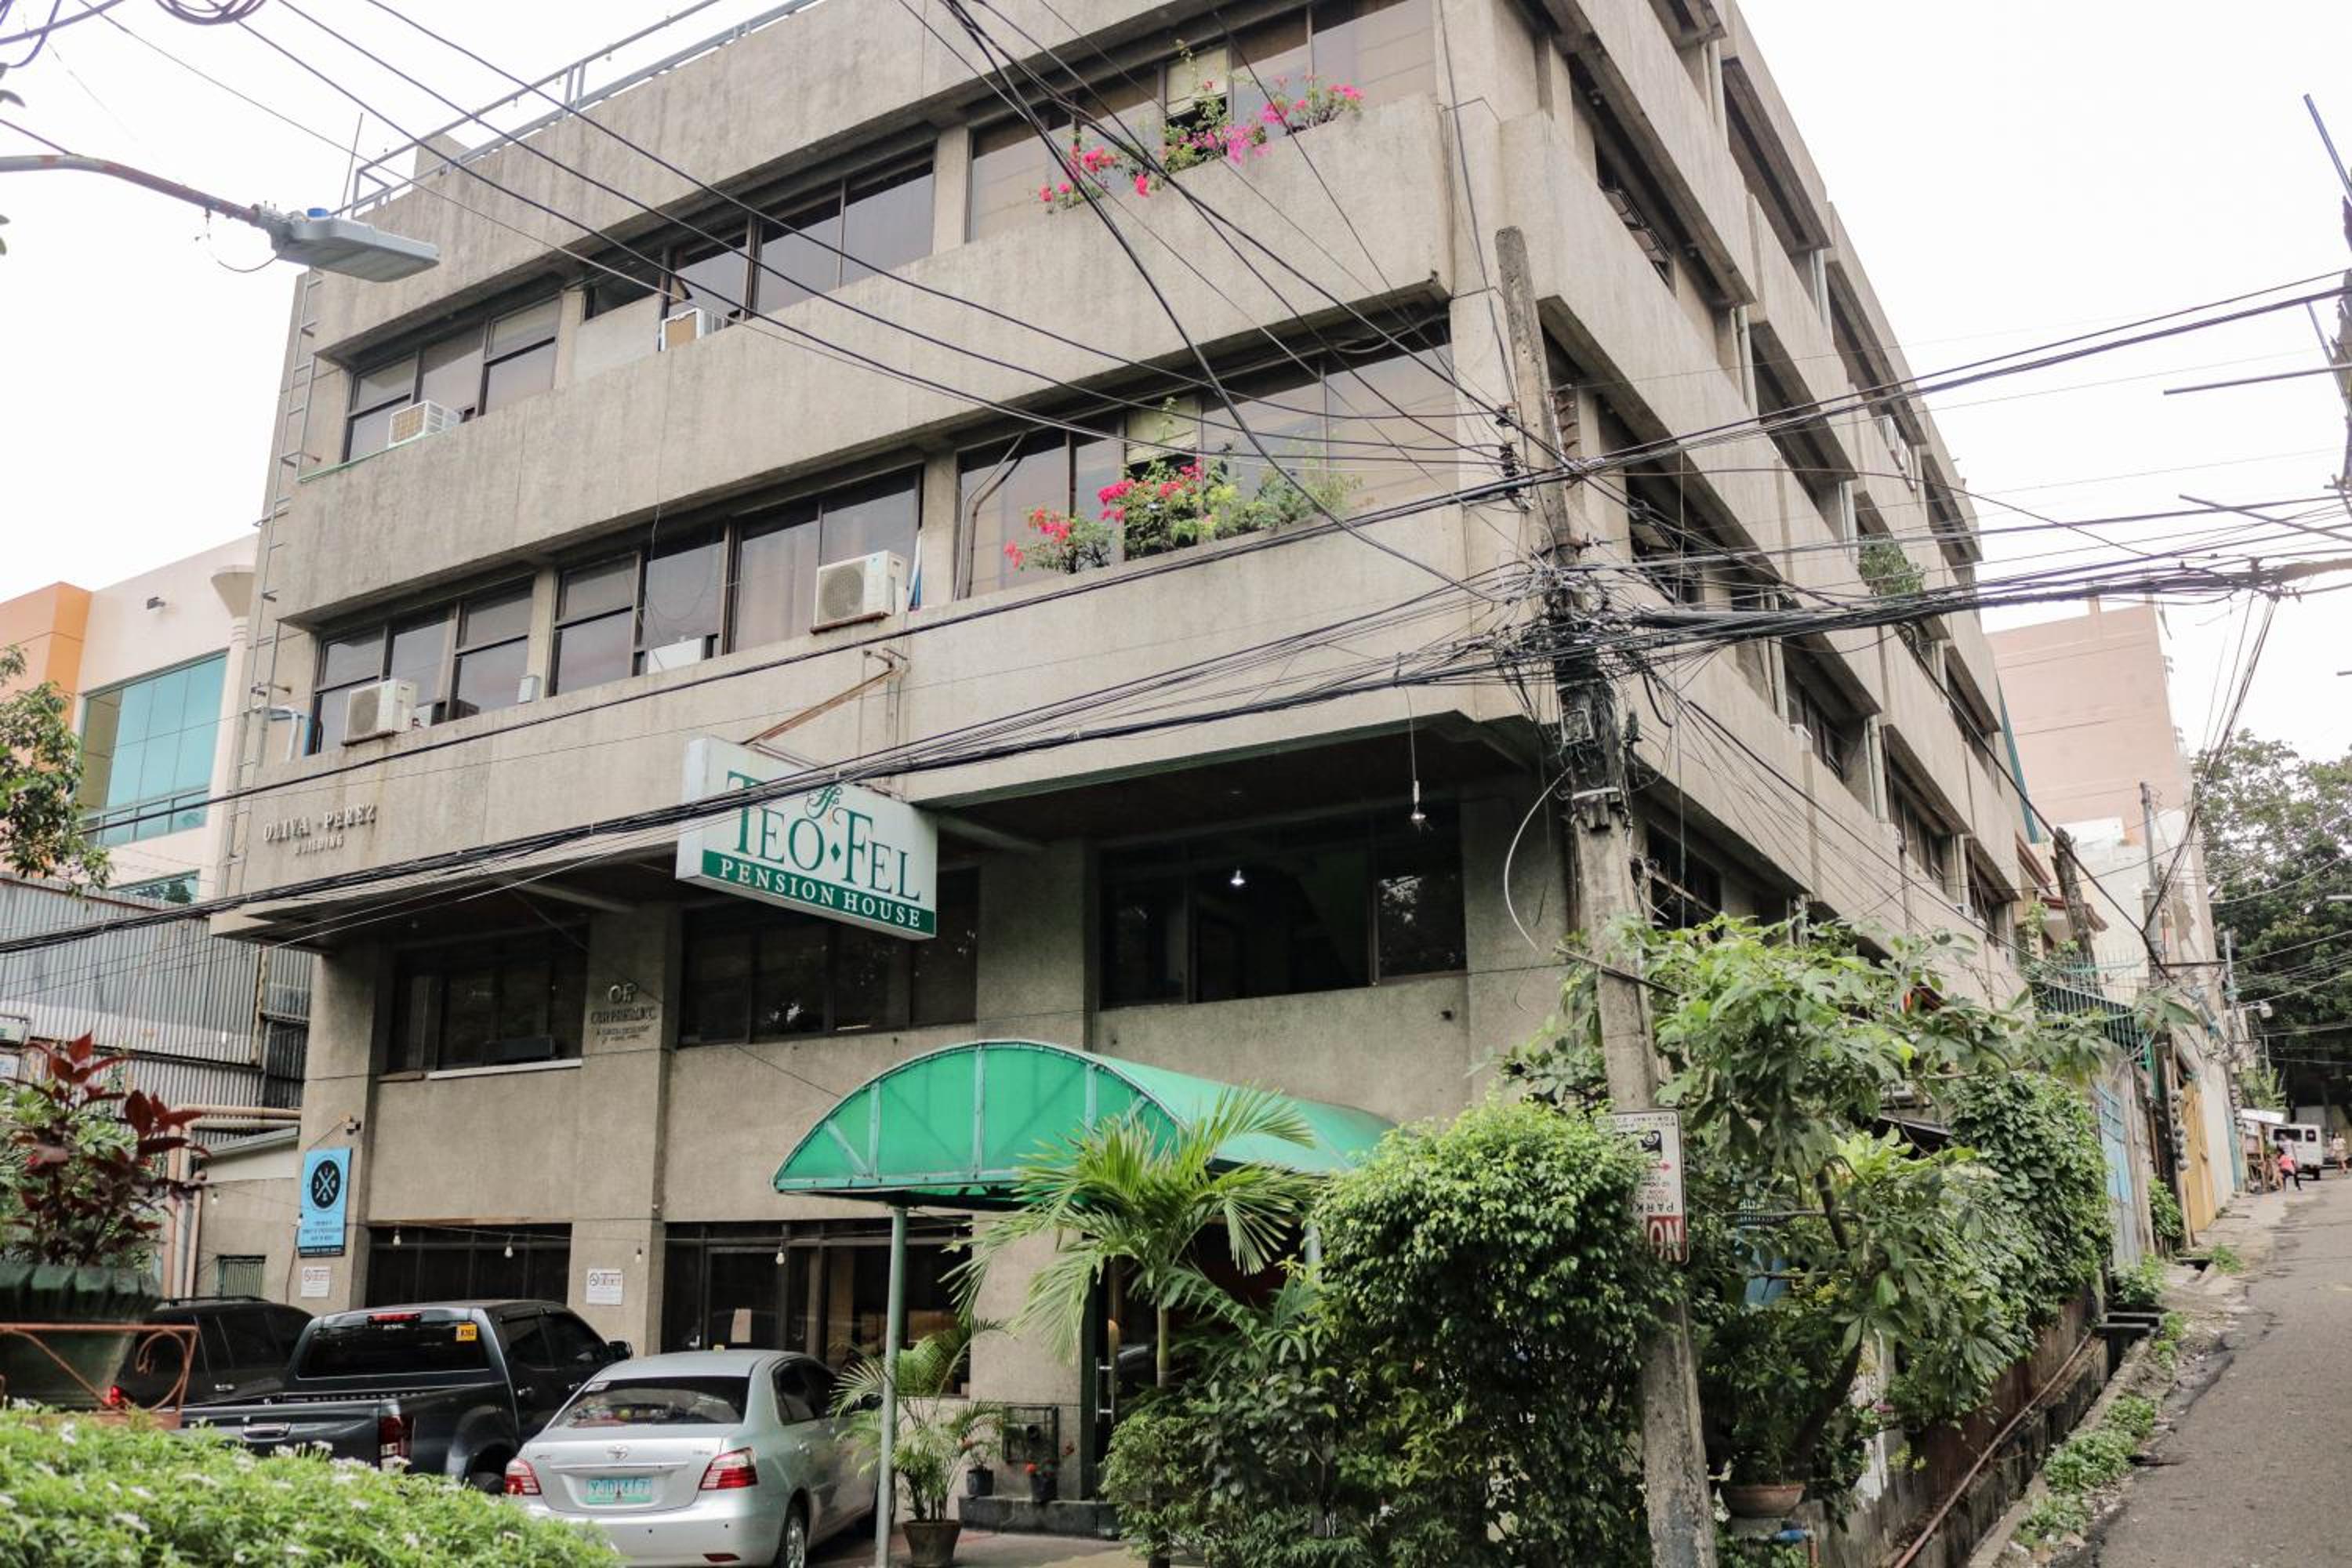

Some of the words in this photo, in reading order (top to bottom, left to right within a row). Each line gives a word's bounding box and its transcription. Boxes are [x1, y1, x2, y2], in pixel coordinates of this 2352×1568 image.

[324, 804, 377, 829] PEREZ
[727, 771, 824, 870] TEO
[833, 808, 920, 901] FEL
[719, 858, 835, 905] PENSION
[843, 891, 920, 927] HOUSE
[1630, 1203, 1674, 1214] PARKI
[1650, 1220, 1681, 1262] NO
